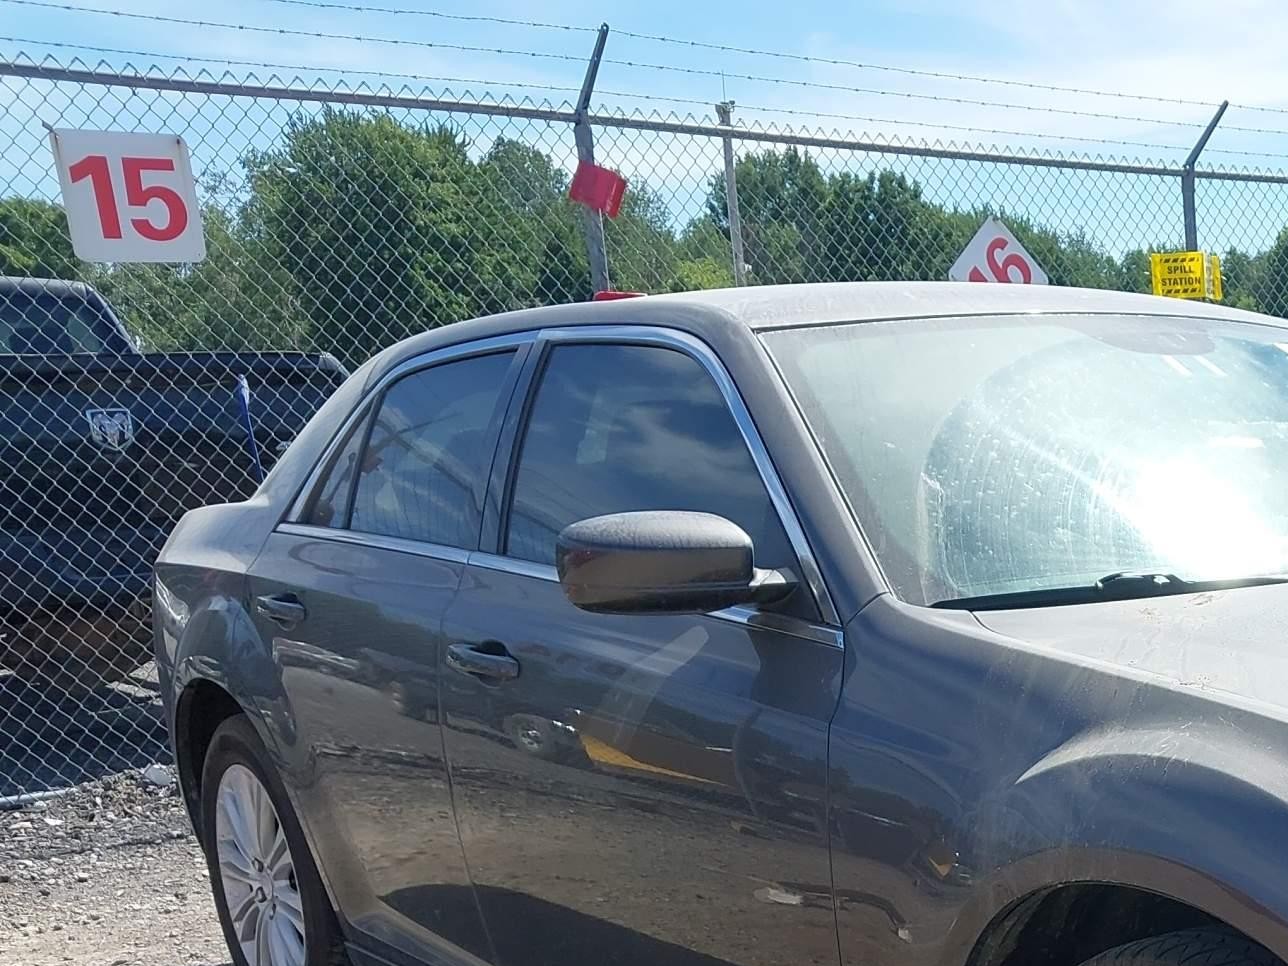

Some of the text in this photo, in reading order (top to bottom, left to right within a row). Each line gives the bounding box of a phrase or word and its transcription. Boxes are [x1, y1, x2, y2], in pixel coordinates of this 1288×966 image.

[69, 155, 188, 242] 15
[968, 237, 1032, 285] 6
[1167, 265, 1195, 275] SPILL
[1160, 276, 1202, 287] STATION
